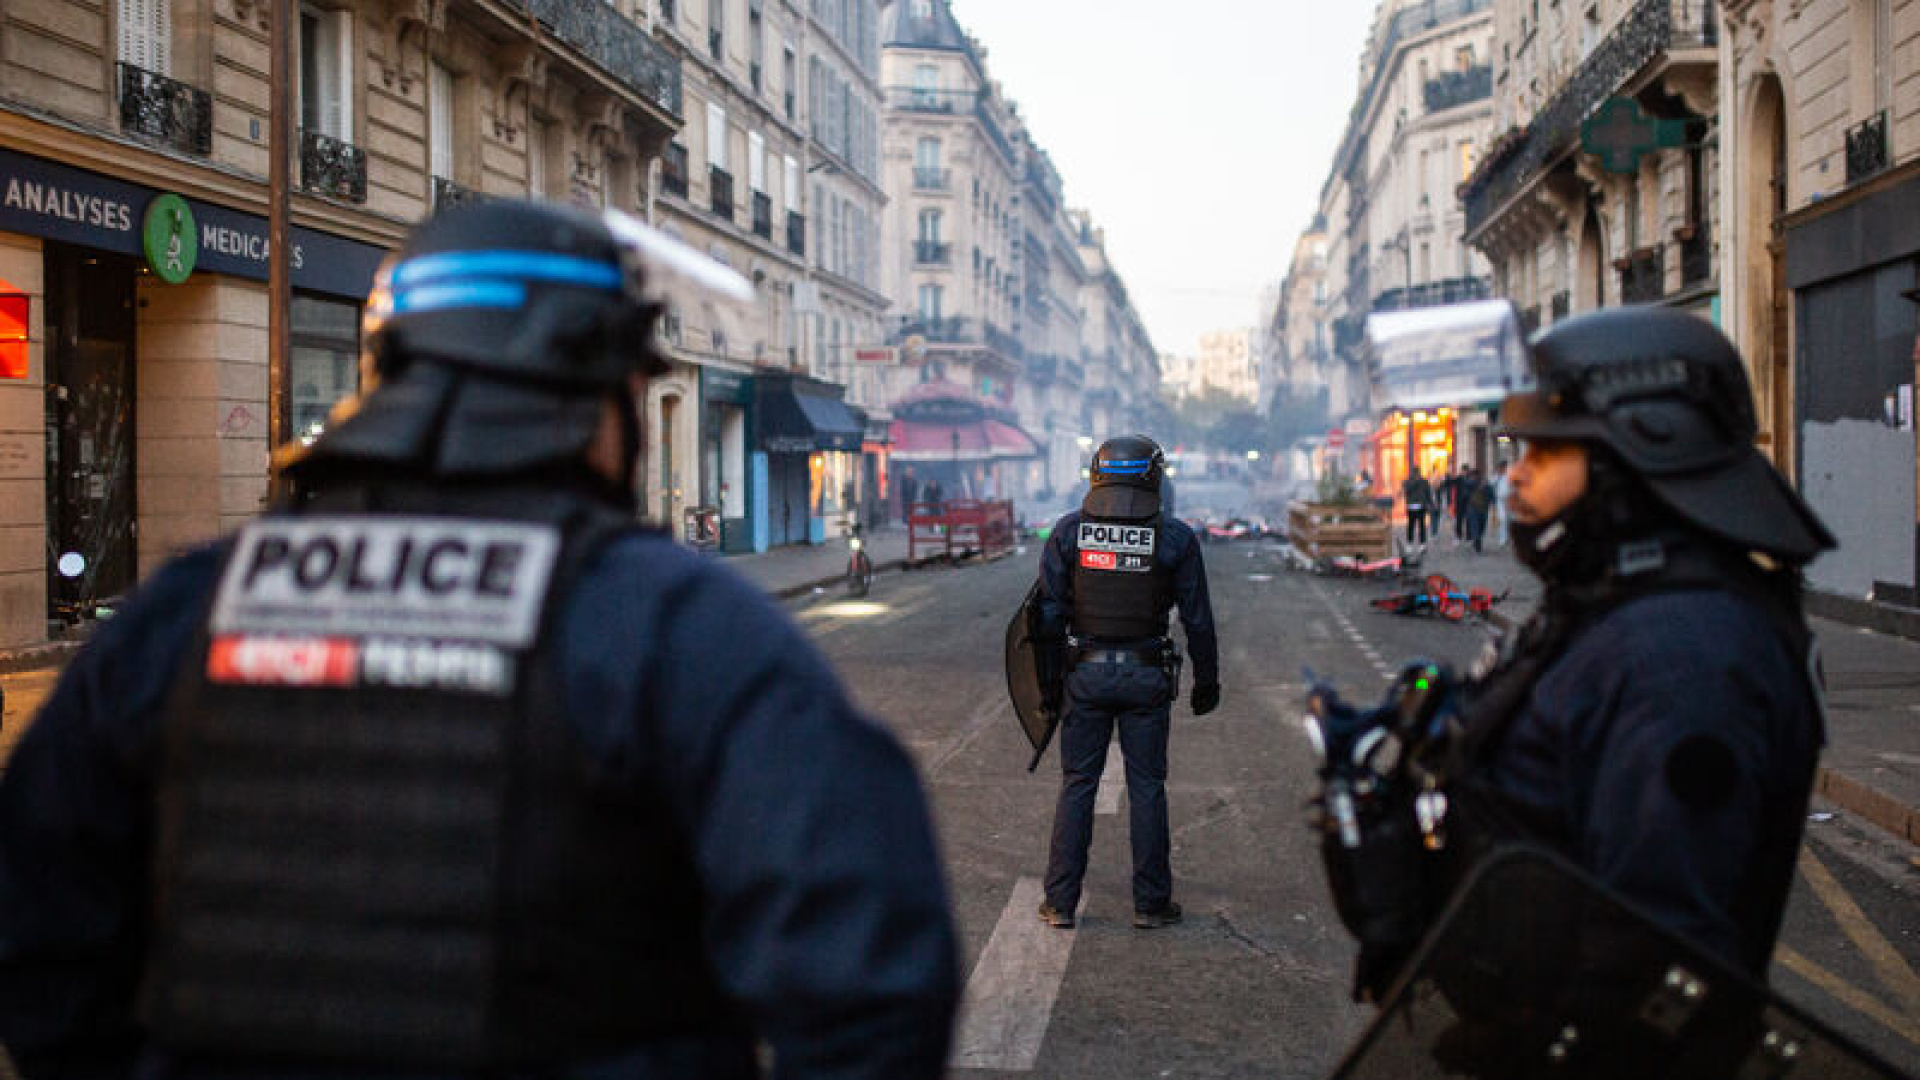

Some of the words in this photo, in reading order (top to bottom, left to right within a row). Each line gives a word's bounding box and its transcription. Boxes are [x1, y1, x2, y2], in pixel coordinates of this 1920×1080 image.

[4, 177, 132, 231] ANALYSES
[203, 223, 304, 270] MEDICAS
[243, 535, 526, 598] POLICE
[1081, 525, 1151, 546] POLICE
